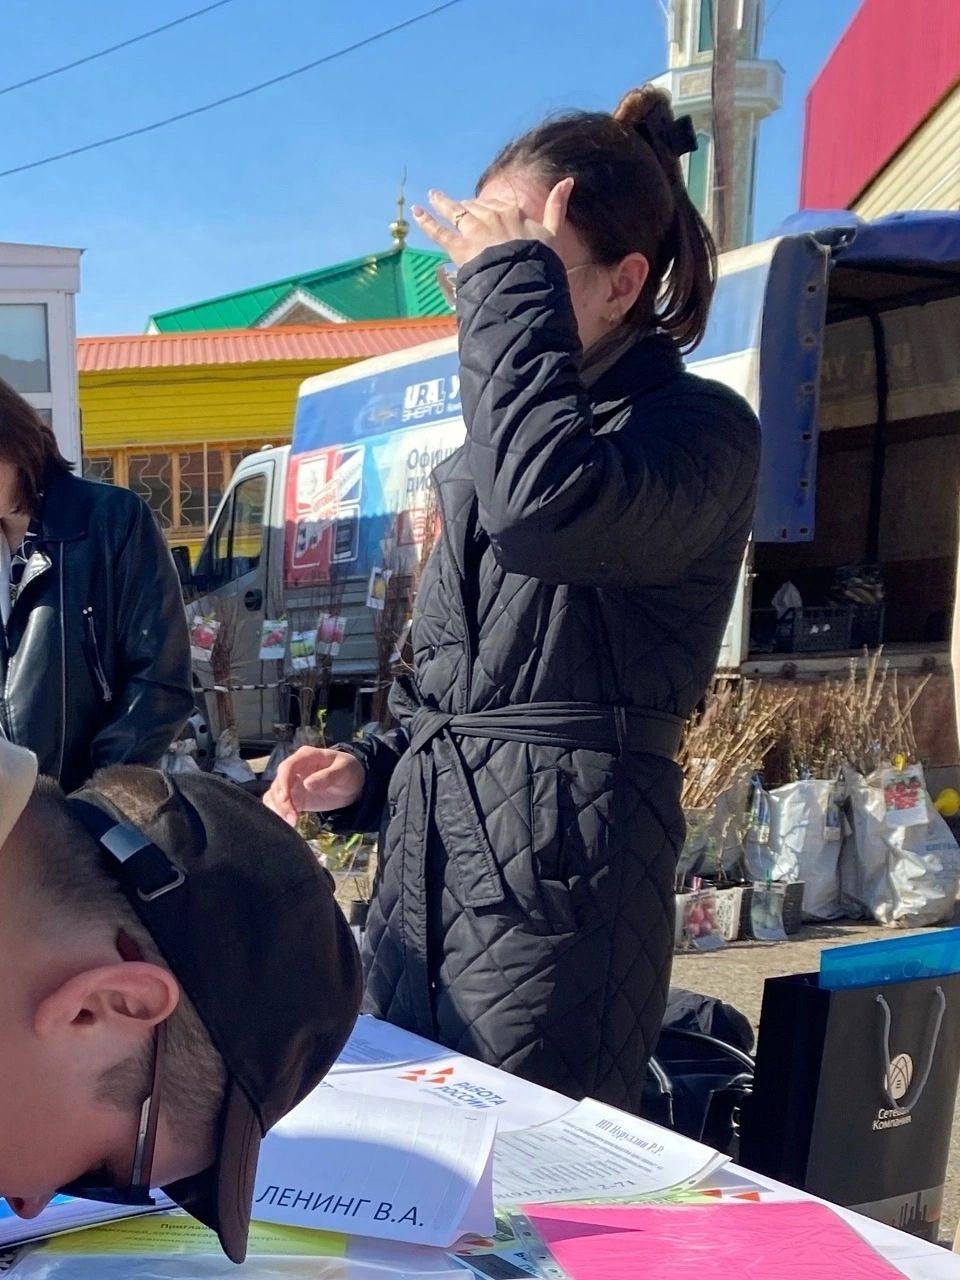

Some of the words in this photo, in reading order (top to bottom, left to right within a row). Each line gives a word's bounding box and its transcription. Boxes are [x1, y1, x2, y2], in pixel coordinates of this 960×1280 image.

[434, 1086, 491, 1109] РОССИИ
[453, 1081, 507, 1106] РАБОТА
[255, 1185, 371, 1217] ЛЕНИНГ
[373, 1202, 424, 1227] В.А.
